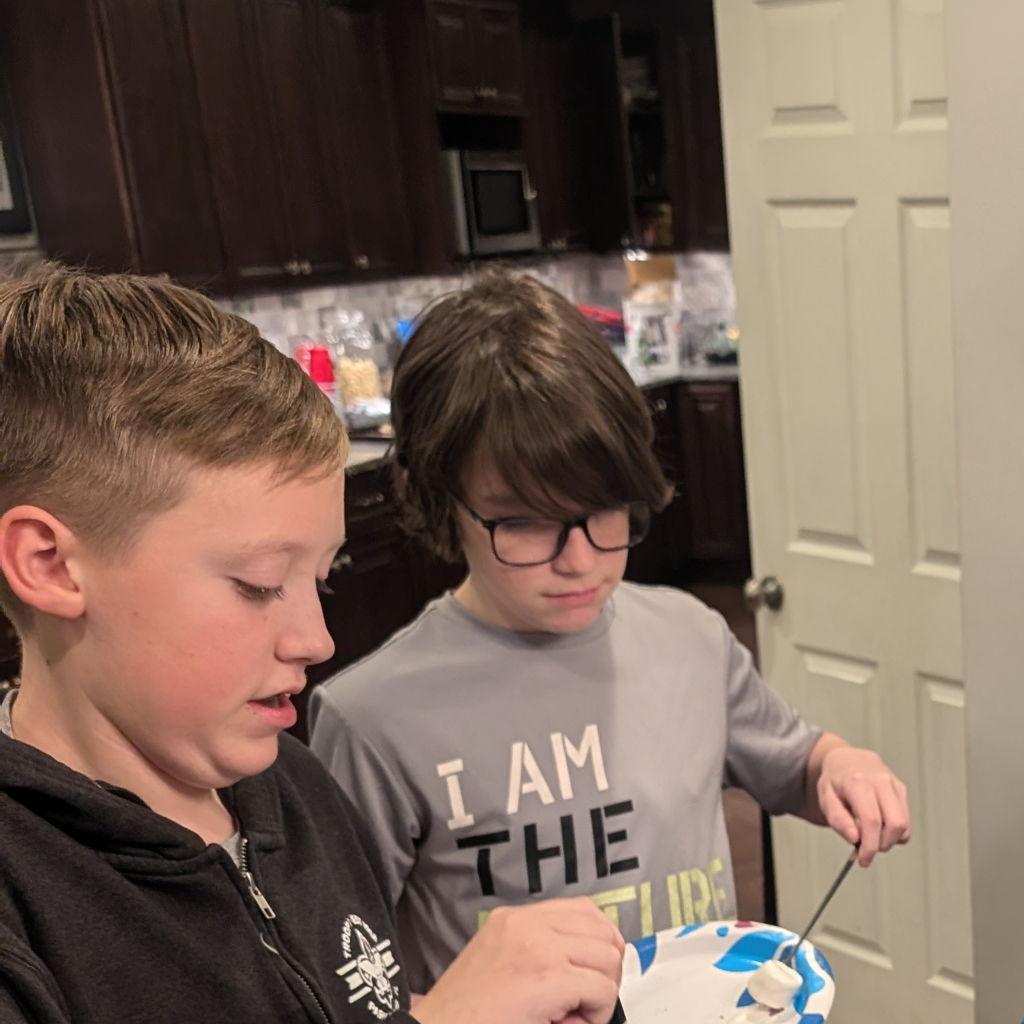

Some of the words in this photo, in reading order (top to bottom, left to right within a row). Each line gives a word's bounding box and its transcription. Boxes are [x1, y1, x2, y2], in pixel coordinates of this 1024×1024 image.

[436, 758, 475, 830] I
[506, 724, 609, 815] AM
[456, 800, 640, 896] THE
